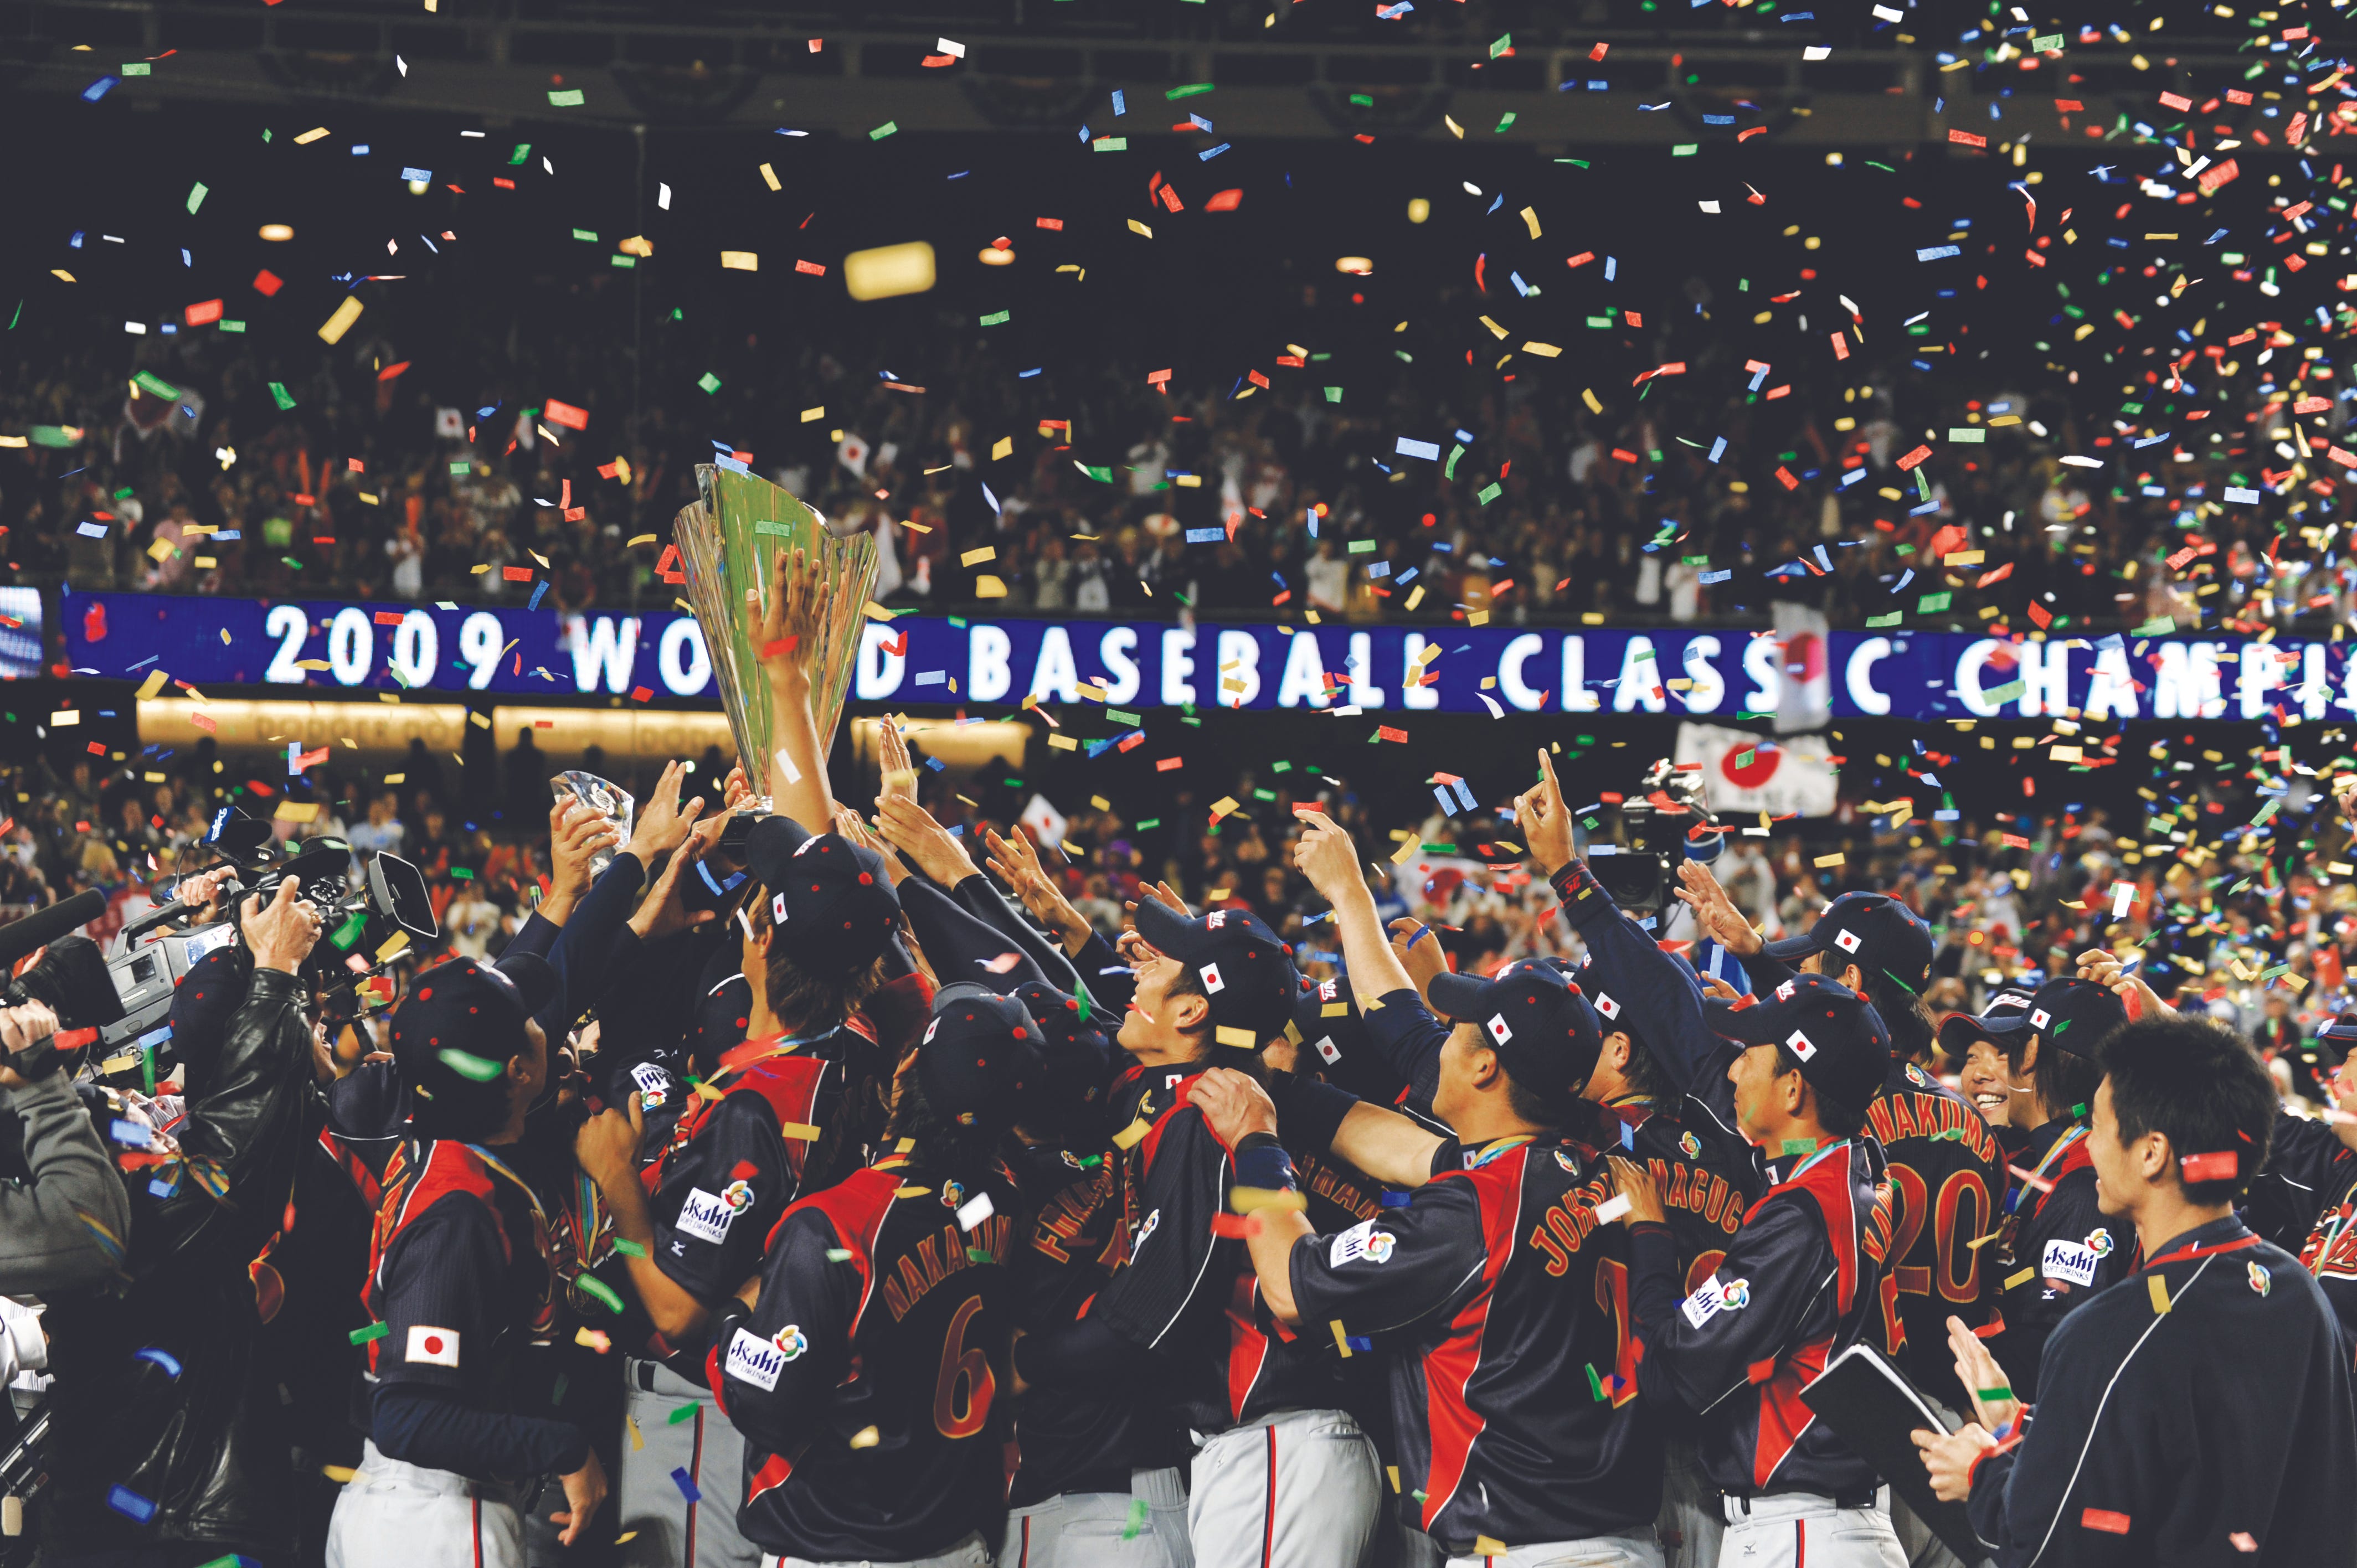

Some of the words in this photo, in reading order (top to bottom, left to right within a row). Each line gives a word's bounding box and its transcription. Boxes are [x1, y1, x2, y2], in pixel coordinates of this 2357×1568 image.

[265, 605, 503, 690] 2009
[569, 616, 905, 699] WOD
[968, 624, 1439, 710] BASEBALL
[1499, 633, 1891, 714] CLASSC
[1955, 638, 2357, 719] CHAMPI
[1859, 1091, 1996, 1164] WAKUMA
[683, 1196, 732, 1230] Asahi
[1648, 1158, 1743, 1234] MAGUC
[1887, 1162, 1991, 1303] 20
[2045, 1245, 2095, 1272] Asahi
[2060, 1267, 2090, 1281] DRINKS
[730, 1338, 782, 1375] Asahi
[934, 1294, 996, 1440] 6
